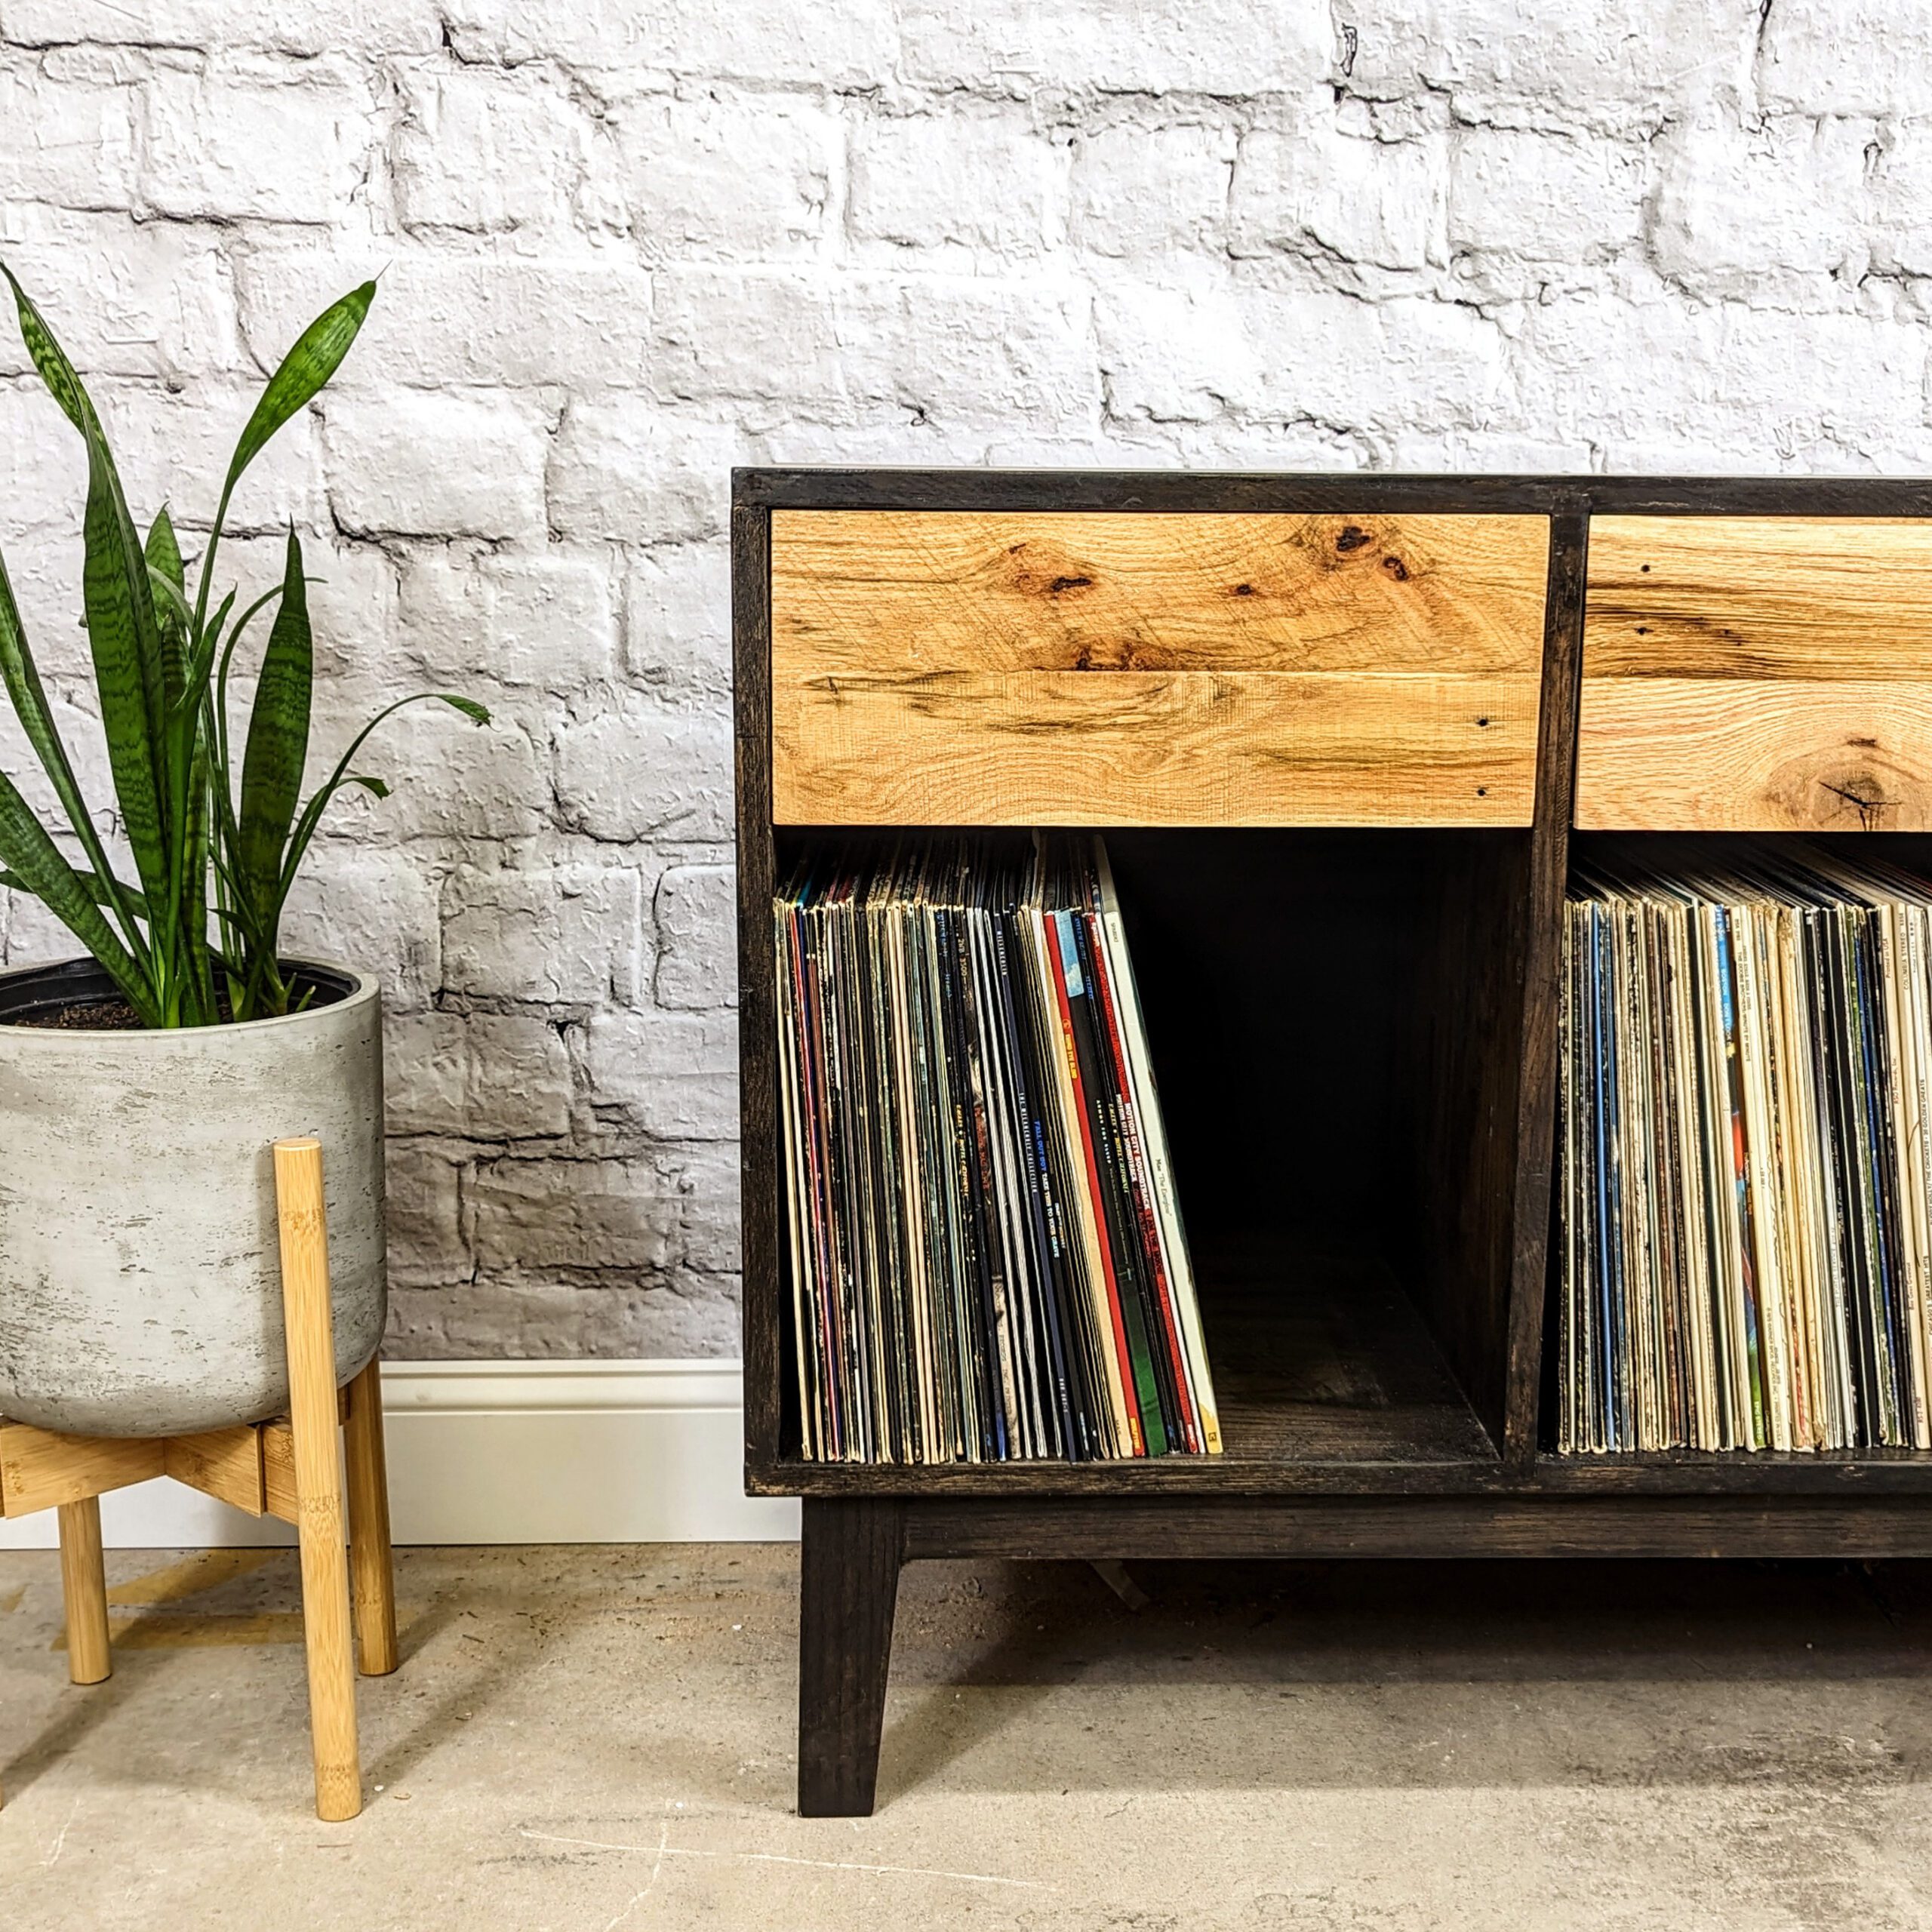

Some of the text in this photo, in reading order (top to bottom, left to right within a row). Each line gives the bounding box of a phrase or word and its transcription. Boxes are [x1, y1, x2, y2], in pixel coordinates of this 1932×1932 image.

[1124, 1103, 1135, 1134] MOTION
[1131, 1136, 1139, 1154] CITY
[1134, 1155, 1149, 1209] SOUNDTRACK
[1047, 1208, 1053, 1217] TO
